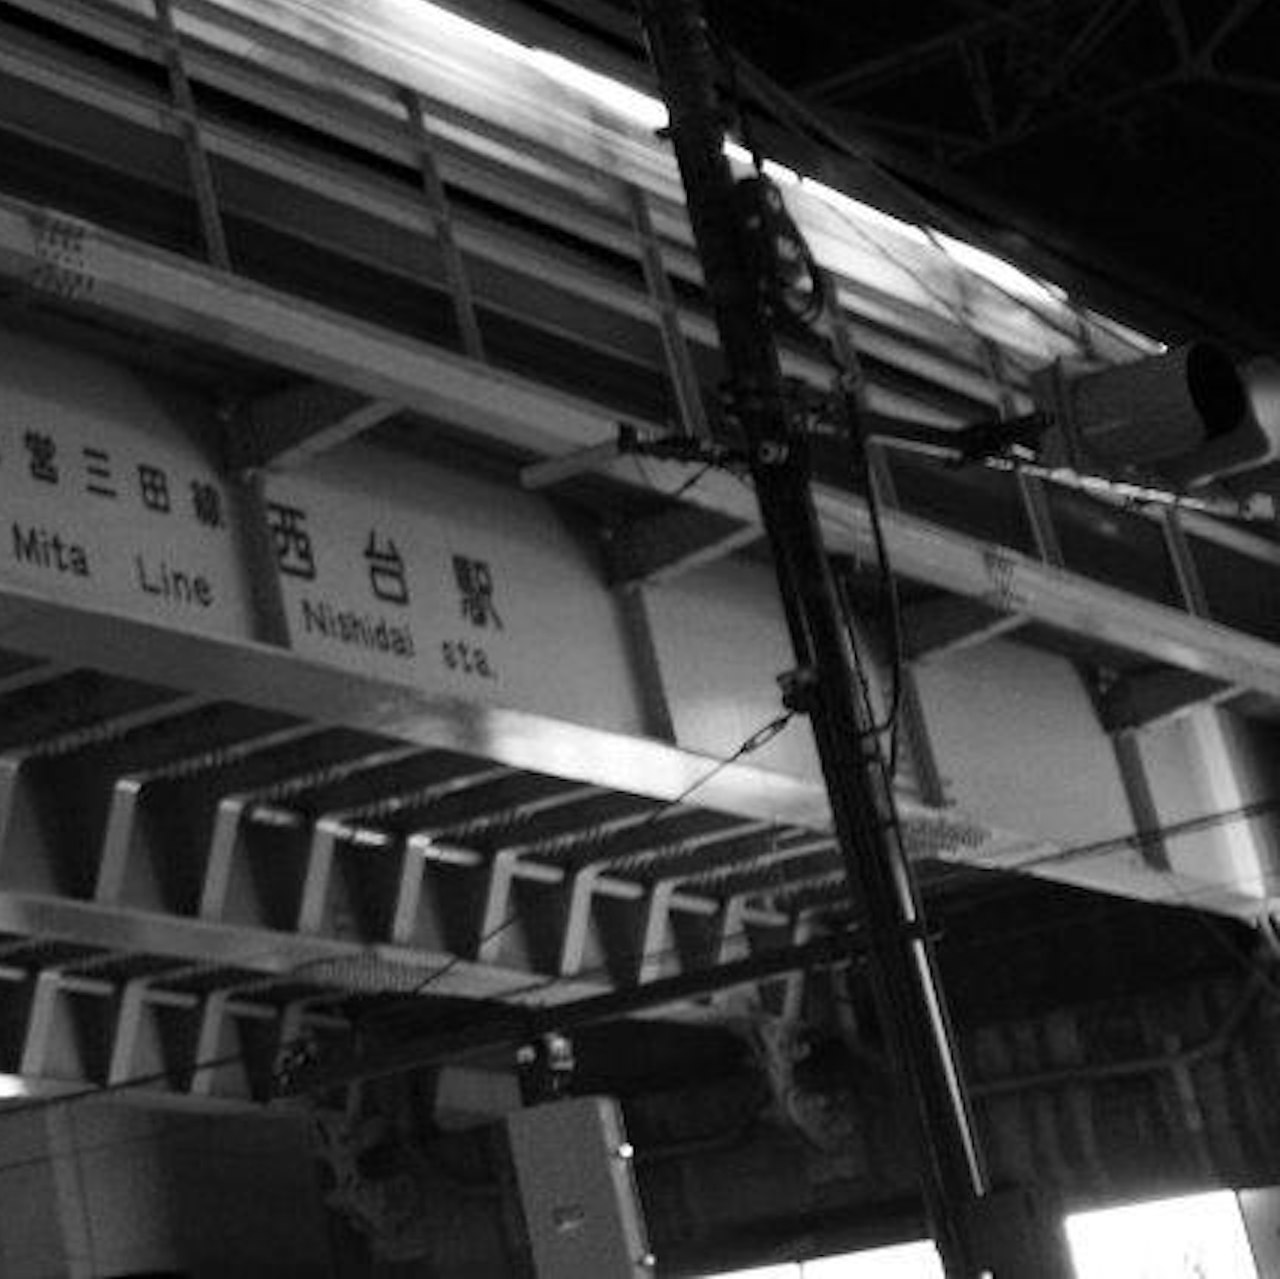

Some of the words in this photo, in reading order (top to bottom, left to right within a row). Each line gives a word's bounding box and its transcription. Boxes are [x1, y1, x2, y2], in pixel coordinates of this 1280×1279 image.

[12, 521, 90, 577] Mita
[135, 553, 215, 608] Line
[267, 502, 504, 631] 西台駅
[301, 599, 417, 658] Nishidai
